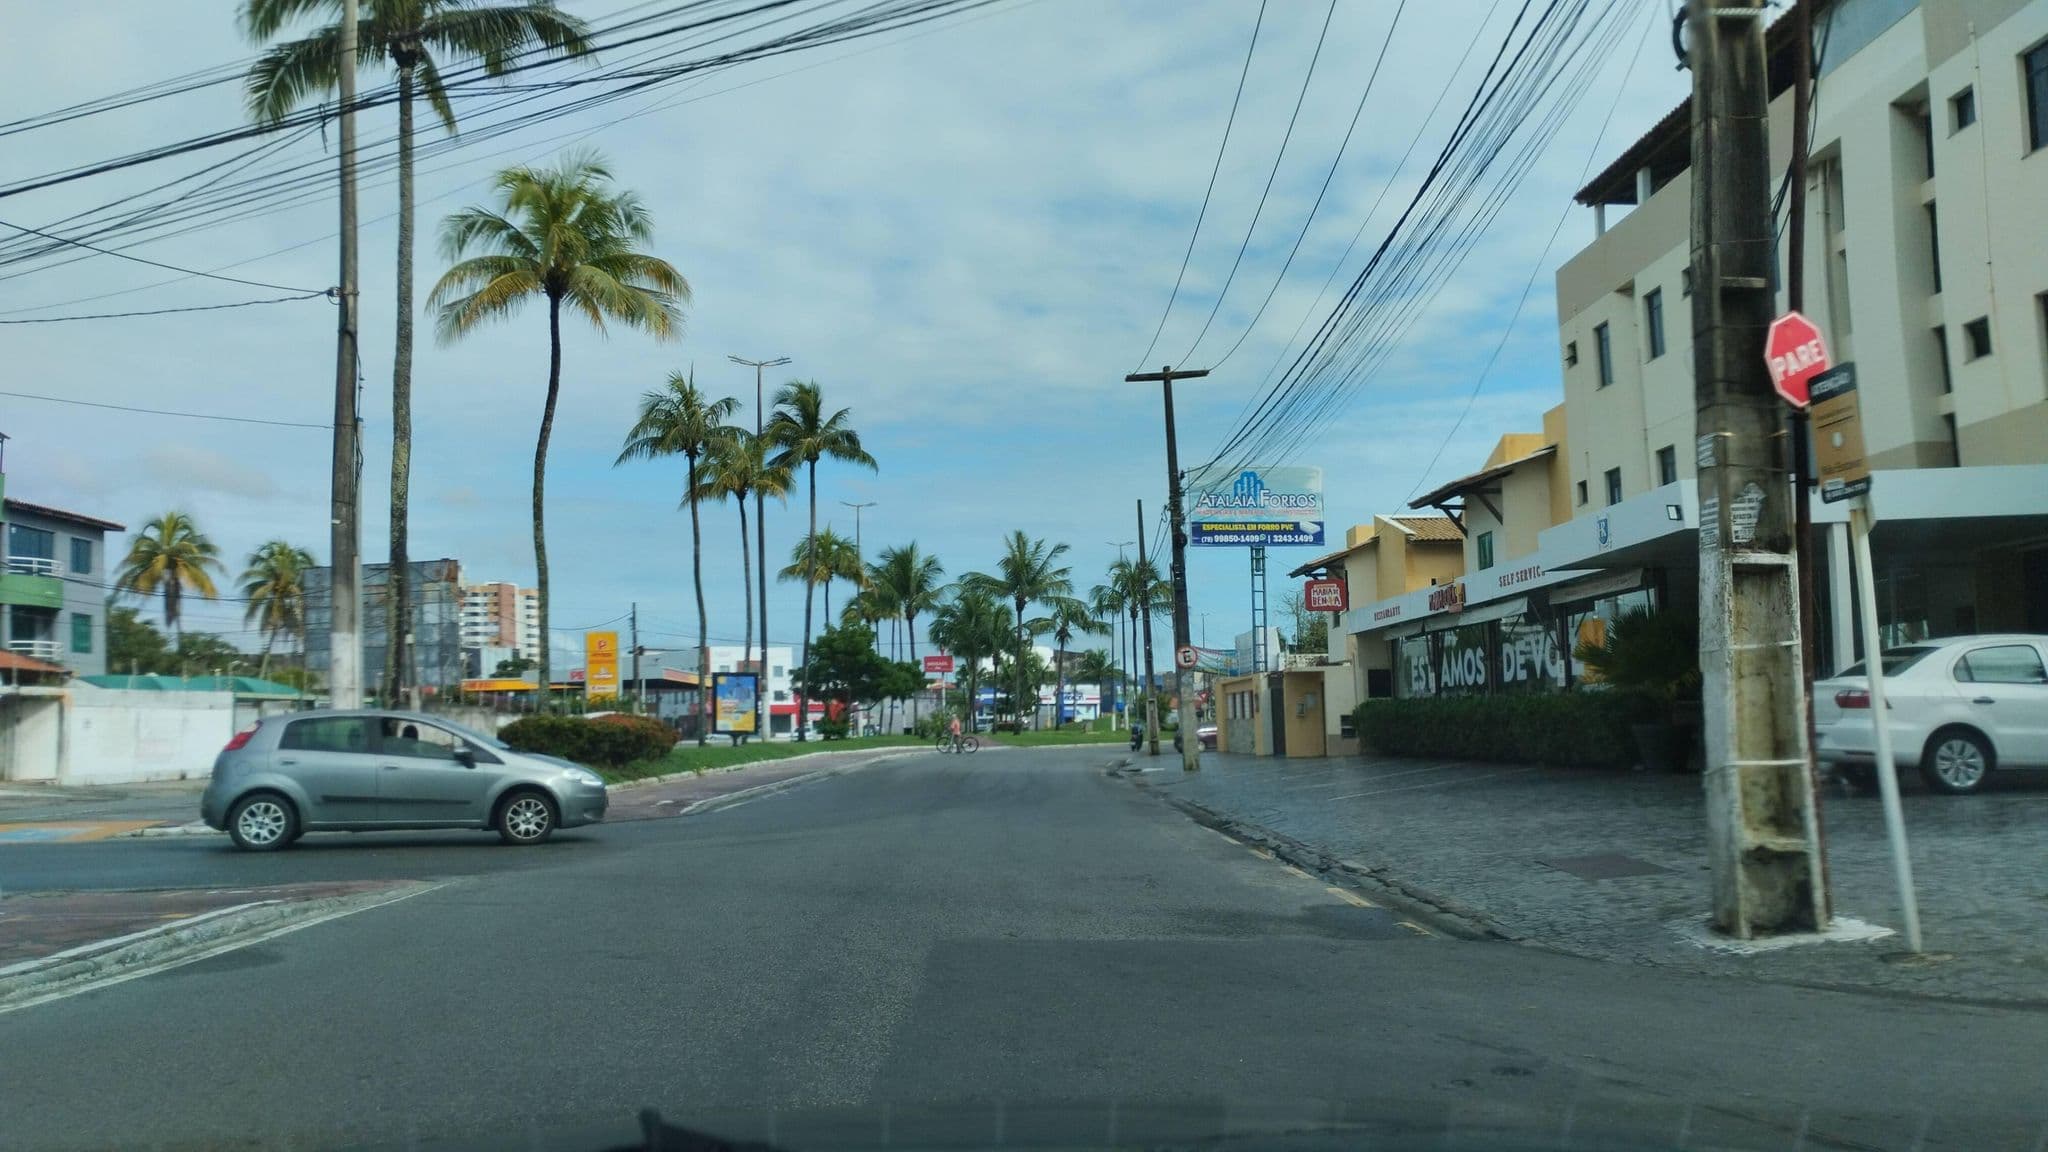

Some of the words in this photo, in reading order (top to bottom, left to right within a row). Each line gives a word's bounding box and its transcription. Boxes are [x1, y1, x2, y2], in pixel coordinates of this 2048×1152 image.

[1771, 338, 1825, 381] PARE
[1197, 490, 1257, 508] ATALAIA
[1259, 488, 1317, 508] FORROS
[1202, 523, 1246, 531] ESPECIALISTA
[1258, 523, 1280, 531] FORRO
[1281, 523, 1294, 531] PVC
[1498, 572, 1516, 588] SELF
